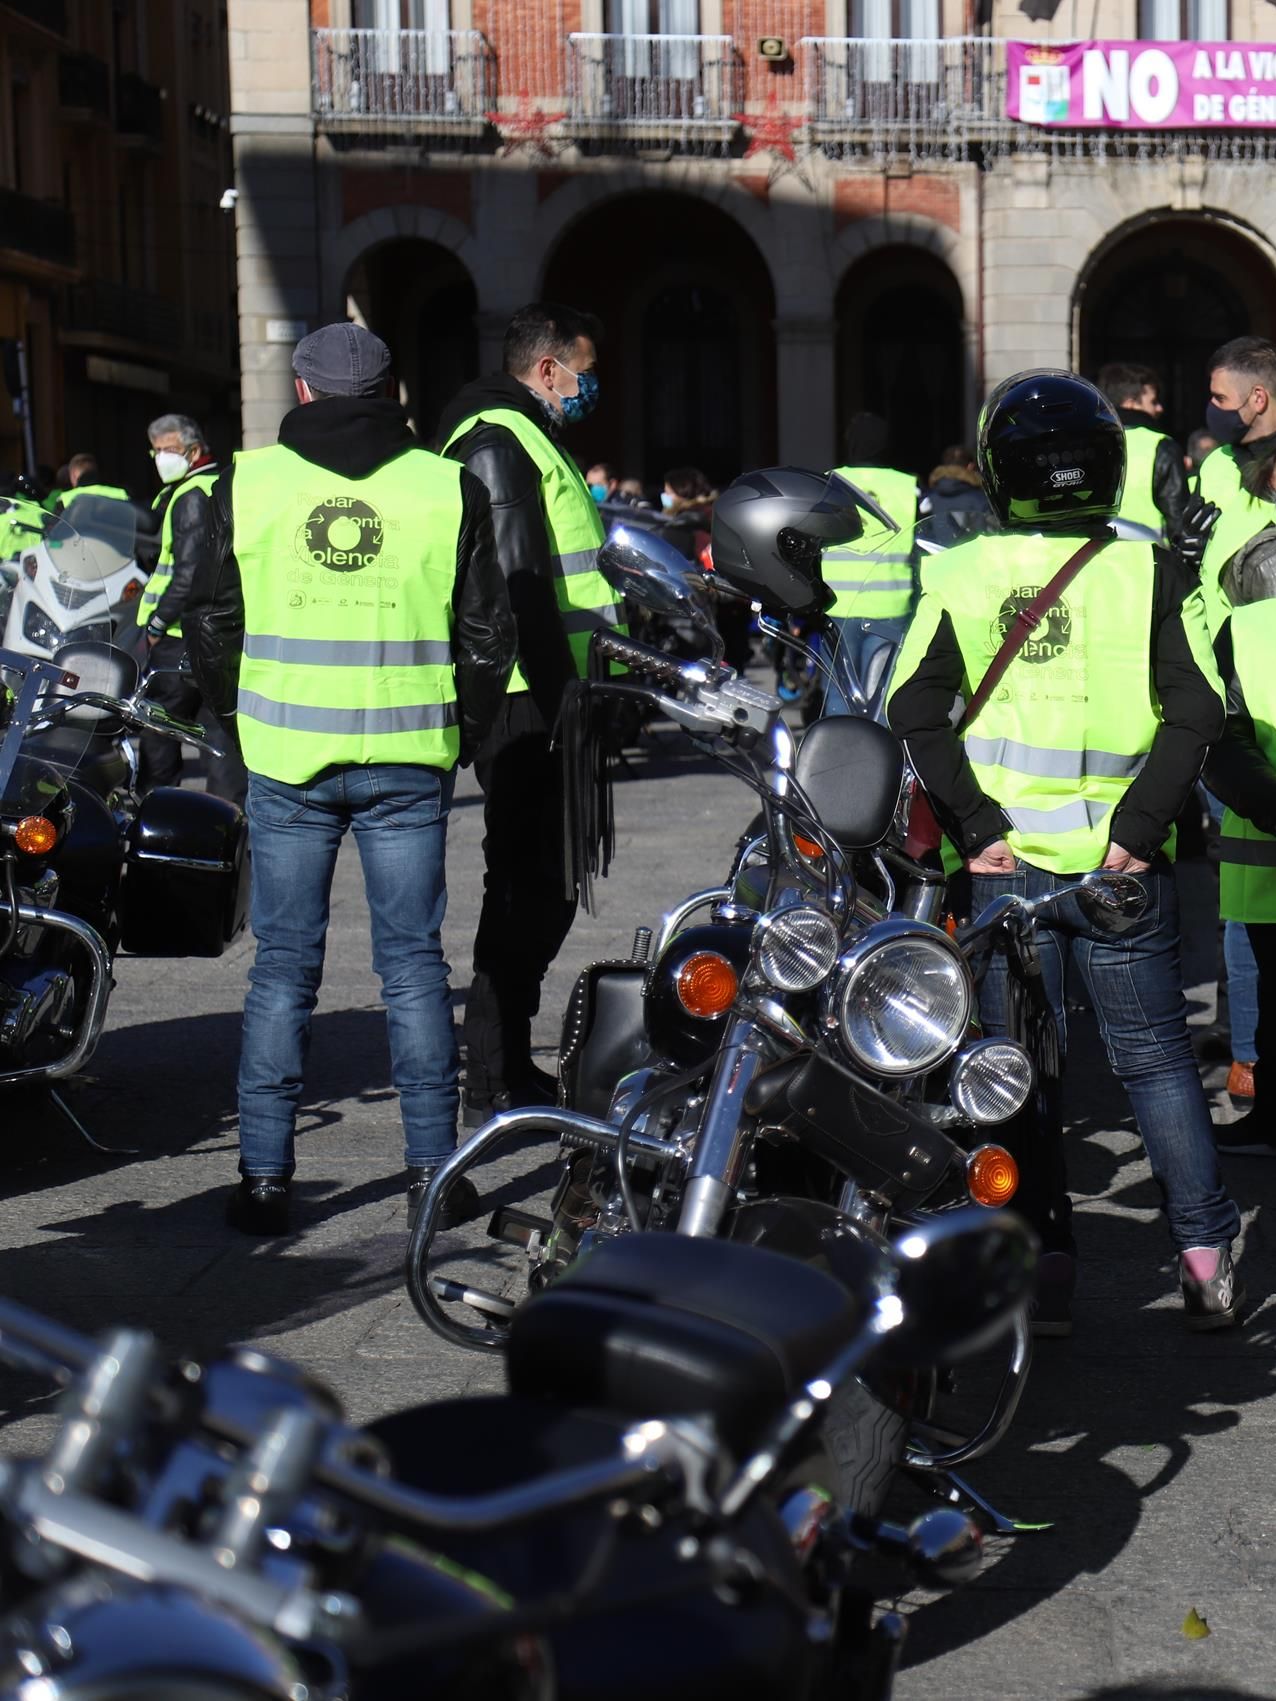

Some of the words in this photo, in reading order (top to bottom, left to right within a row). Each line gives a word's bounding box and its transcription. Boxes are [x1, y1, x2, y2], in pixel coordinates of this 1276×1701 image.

[1192, 51, 1212, 79] A
[1216, 51, 1246, 80] LA
[1082, 49, 1179, 123] NO
[1193, 94, 1225, 121] DE
[1055, 470, 1081, 481] SHOEI
